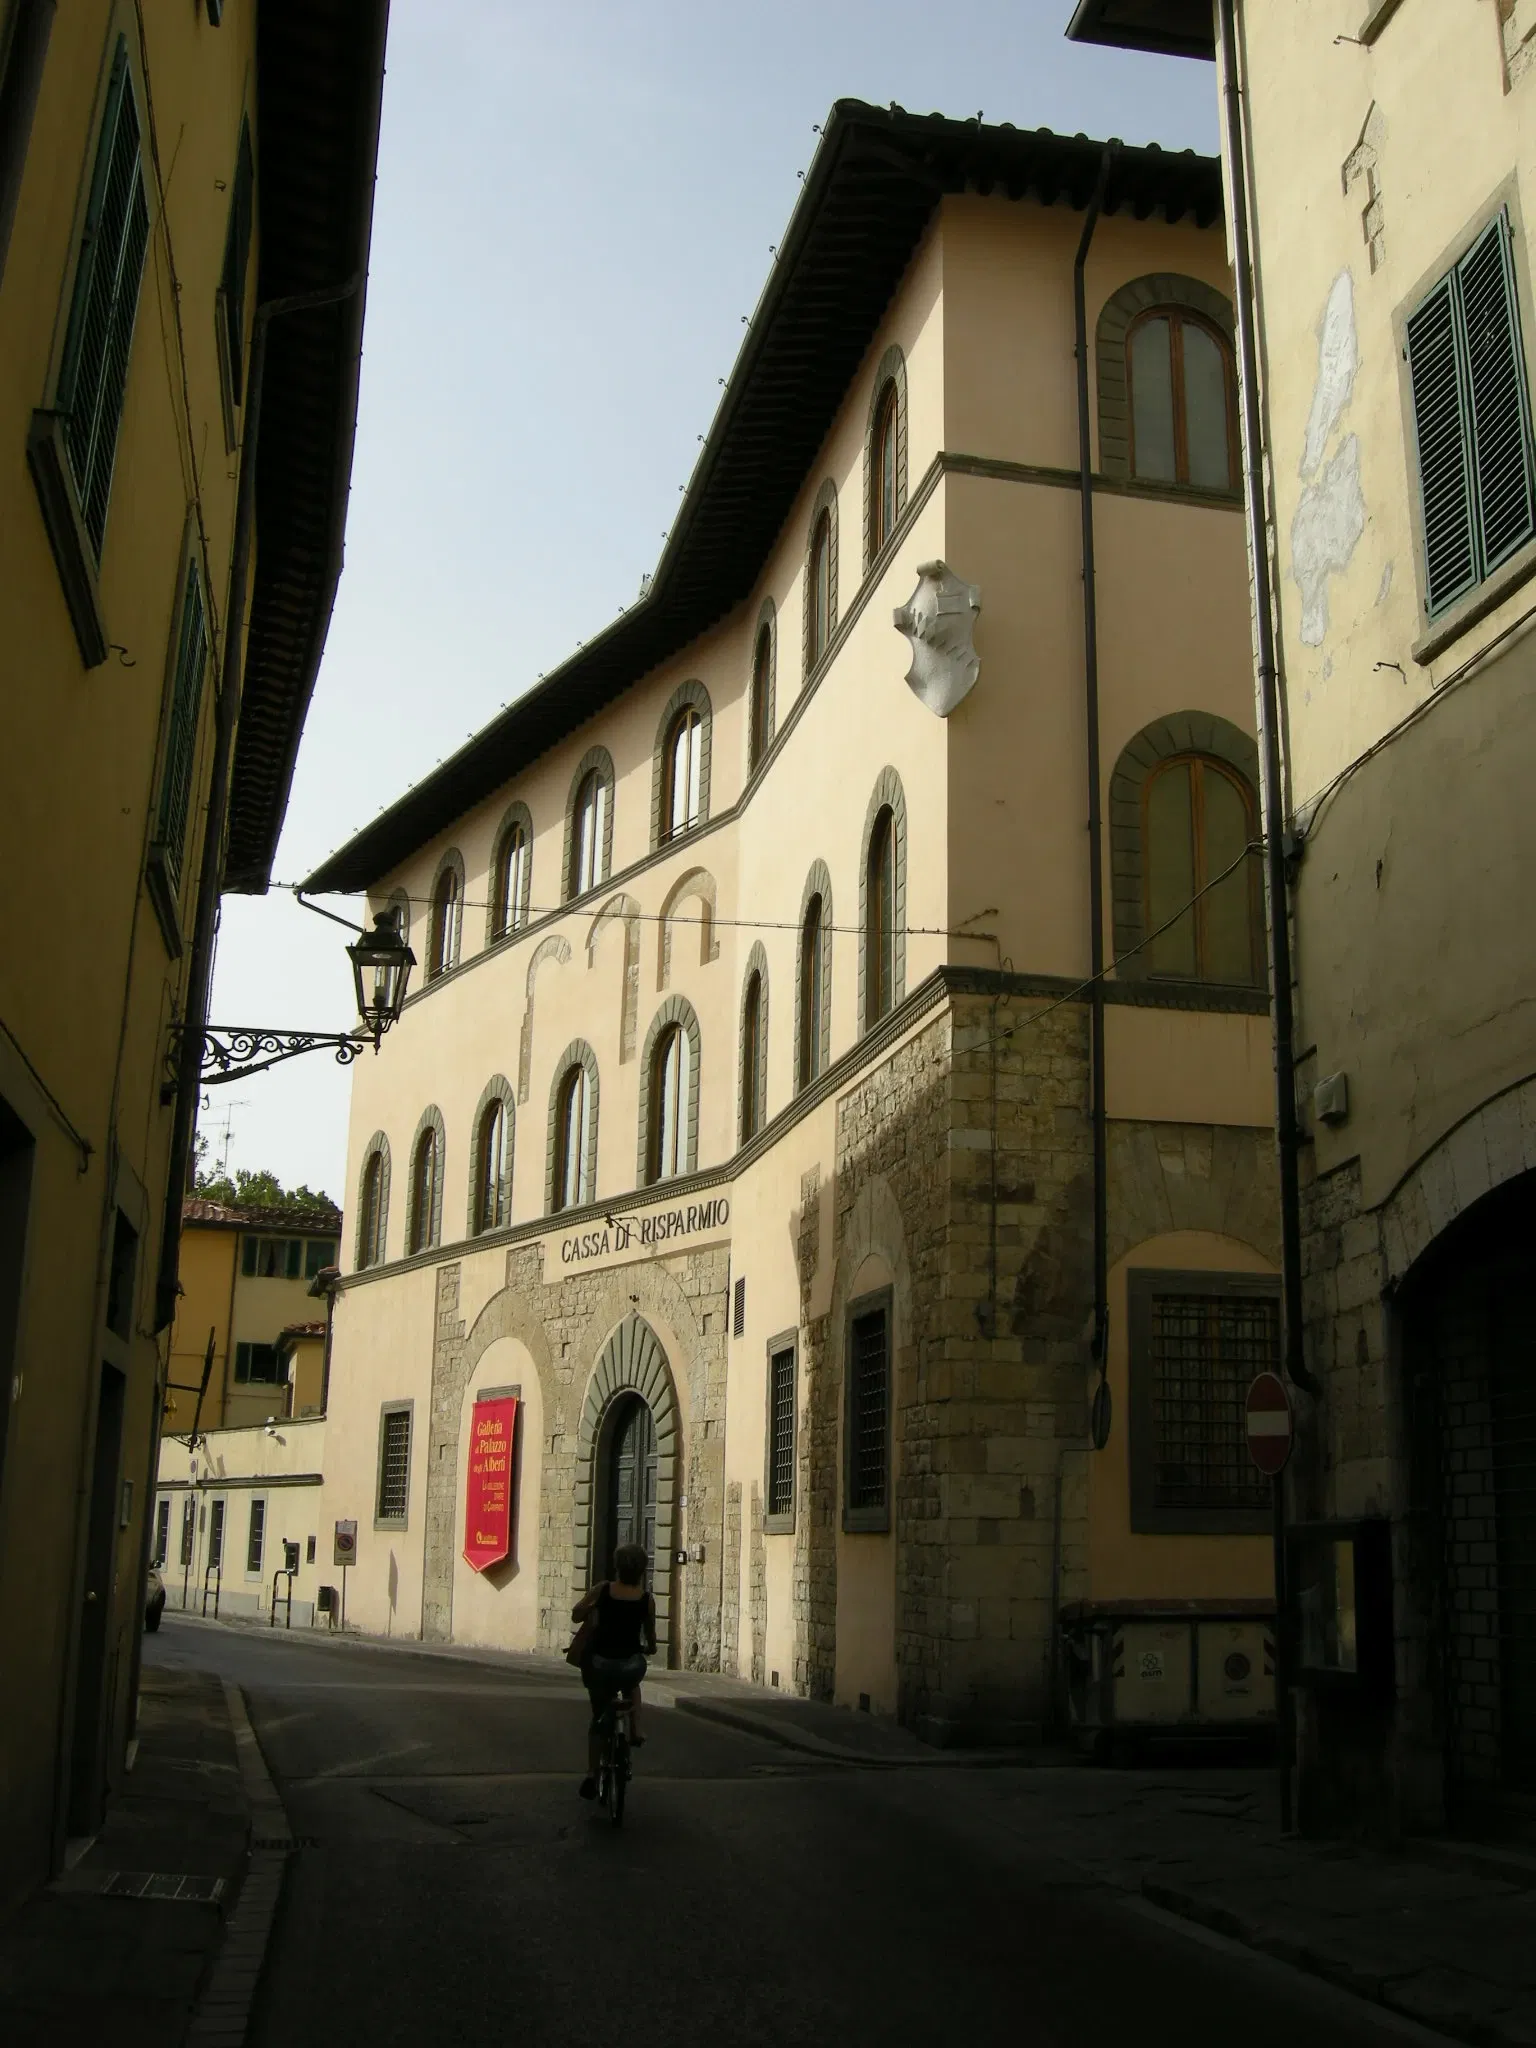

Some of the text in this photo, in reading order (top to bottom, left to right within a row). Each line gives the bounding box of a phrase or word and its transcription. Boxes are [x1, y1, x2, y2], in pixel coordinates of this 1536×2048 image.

[561, 1198, 730, 1263] CASSA DI RISPARMIO
[477, 1419, 503, 1437] Galleria
[479, 1438, 507, 1454] Palazzo
